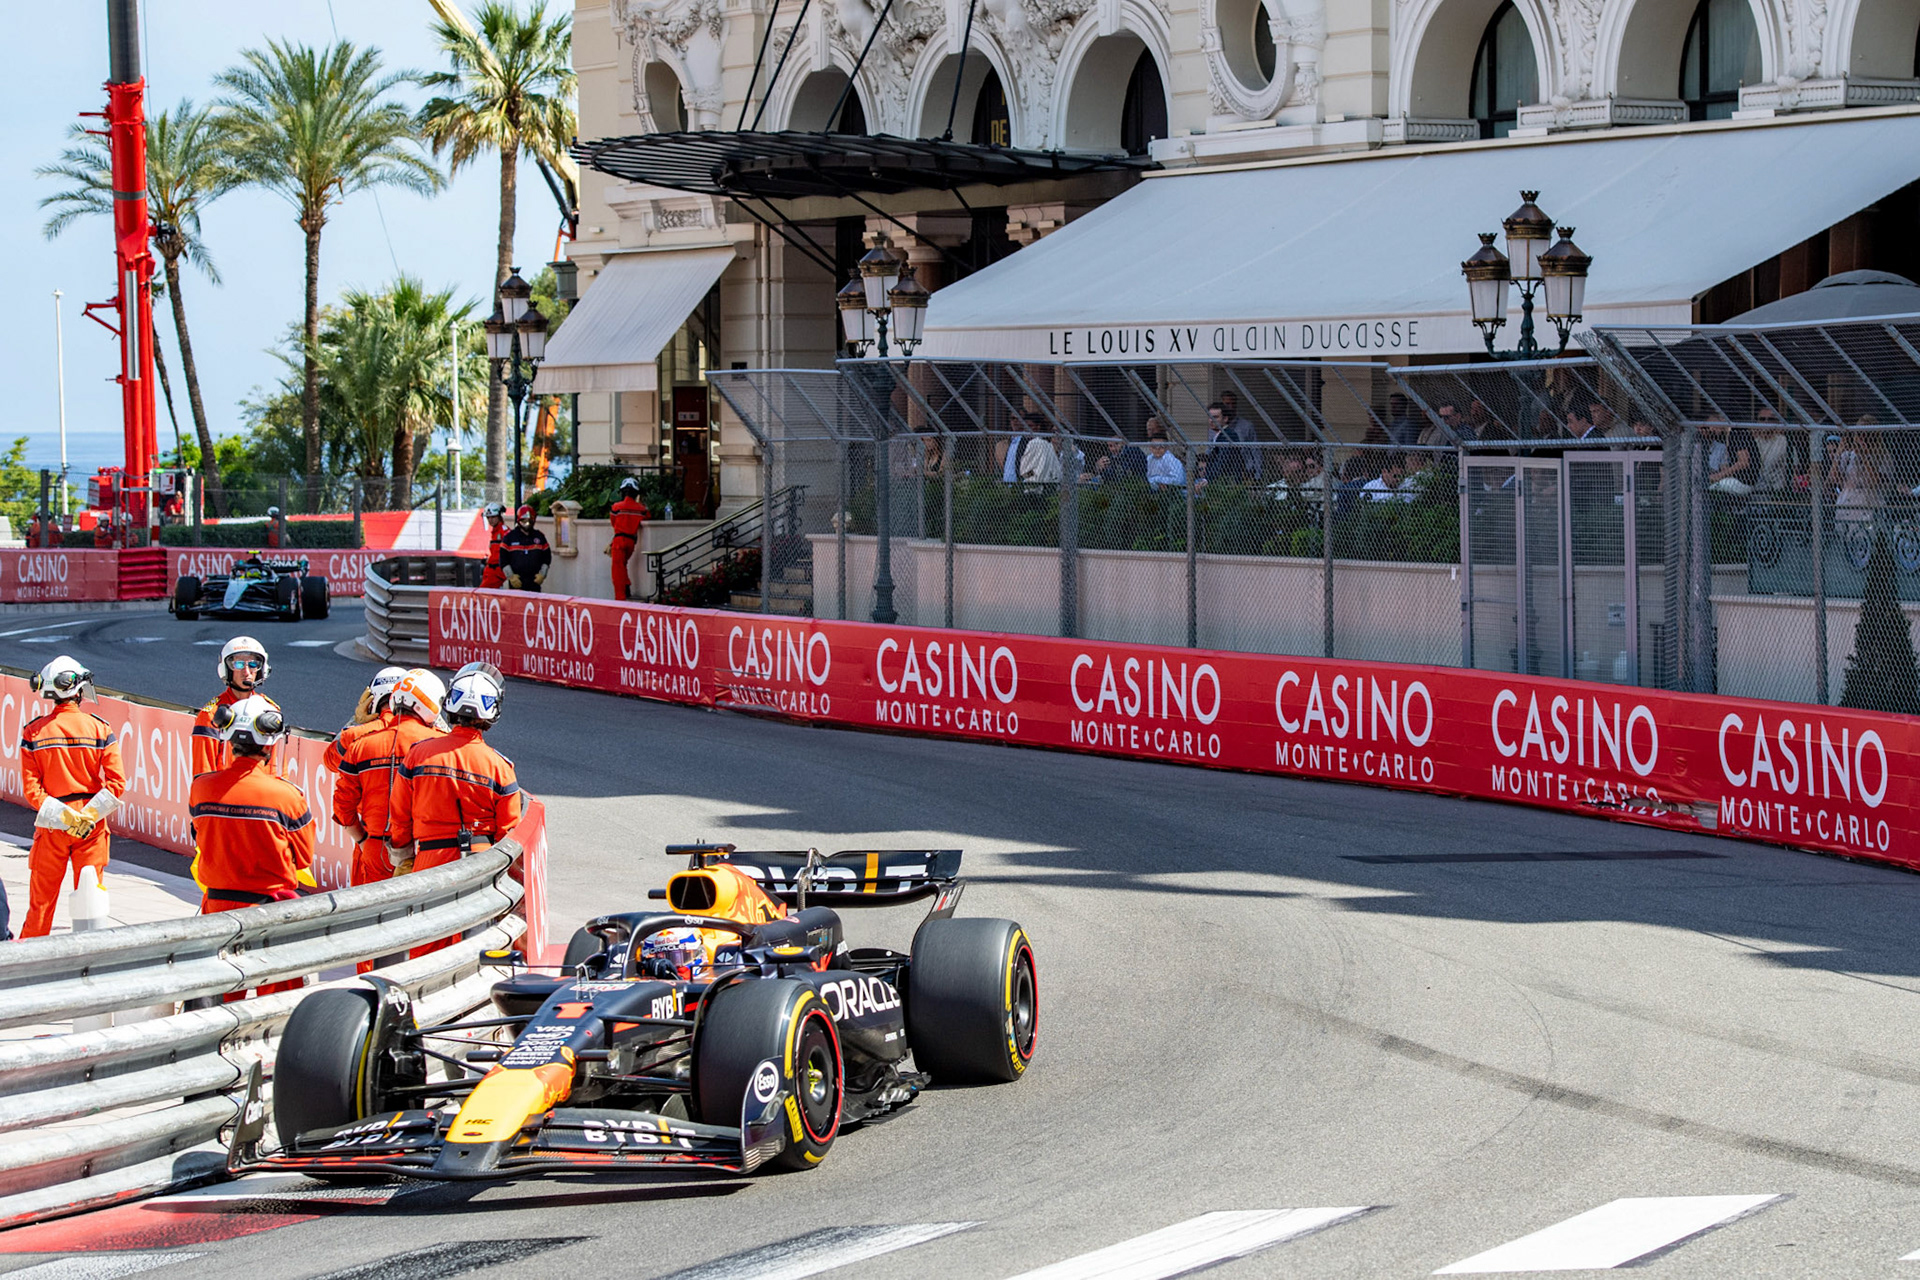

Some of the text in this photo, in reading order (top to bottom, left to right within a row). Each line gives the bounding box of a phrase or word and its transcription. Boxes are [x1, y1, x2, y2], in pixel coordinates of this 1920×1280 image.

[1050, 331, 1073, 355] LE
[1088, 329, 1155, 354] LOUIS
[1169, 328, 1199, 352] XV
[17, 554, 69, 583] CASINO
[439, 595, 502, 643] CASINO
[523, 601, 594, 656] CASINO
[440, 645, 467, 663] MONTE
[619, 611, 700, 670] CASINO
[728, 625, 831, 686] CASINO
[523, 653, 595, 682] MONTE CARLO
[620, 666, 701, 697] MONTE CARLO
[876, 637, 1018, 704] CASINO
[780, 690, 831, 715] CARLO
[1070, 653, 1221, 725] CASINO
[1275, 670, 1433, 747] CASINO
[876, 699, 1019, 735] MONTE CARLO
[1491, 689, 1659, 776] CASINO
[1070, 719, 1221, 759] MONTE CARLO
[119, 721, 193, 804] CASIN
[1275, 741, 1434, 783] MONTE CARLO
[1718, 713, 1888, 808] CASINO
[1491, 764, 1568, 801] MONTE
[117, 801, 162, 838] MONTE
[1721, 795, 1890, 852] MONTE CARLO
[651, 988, 684, 1019] BYBIT
